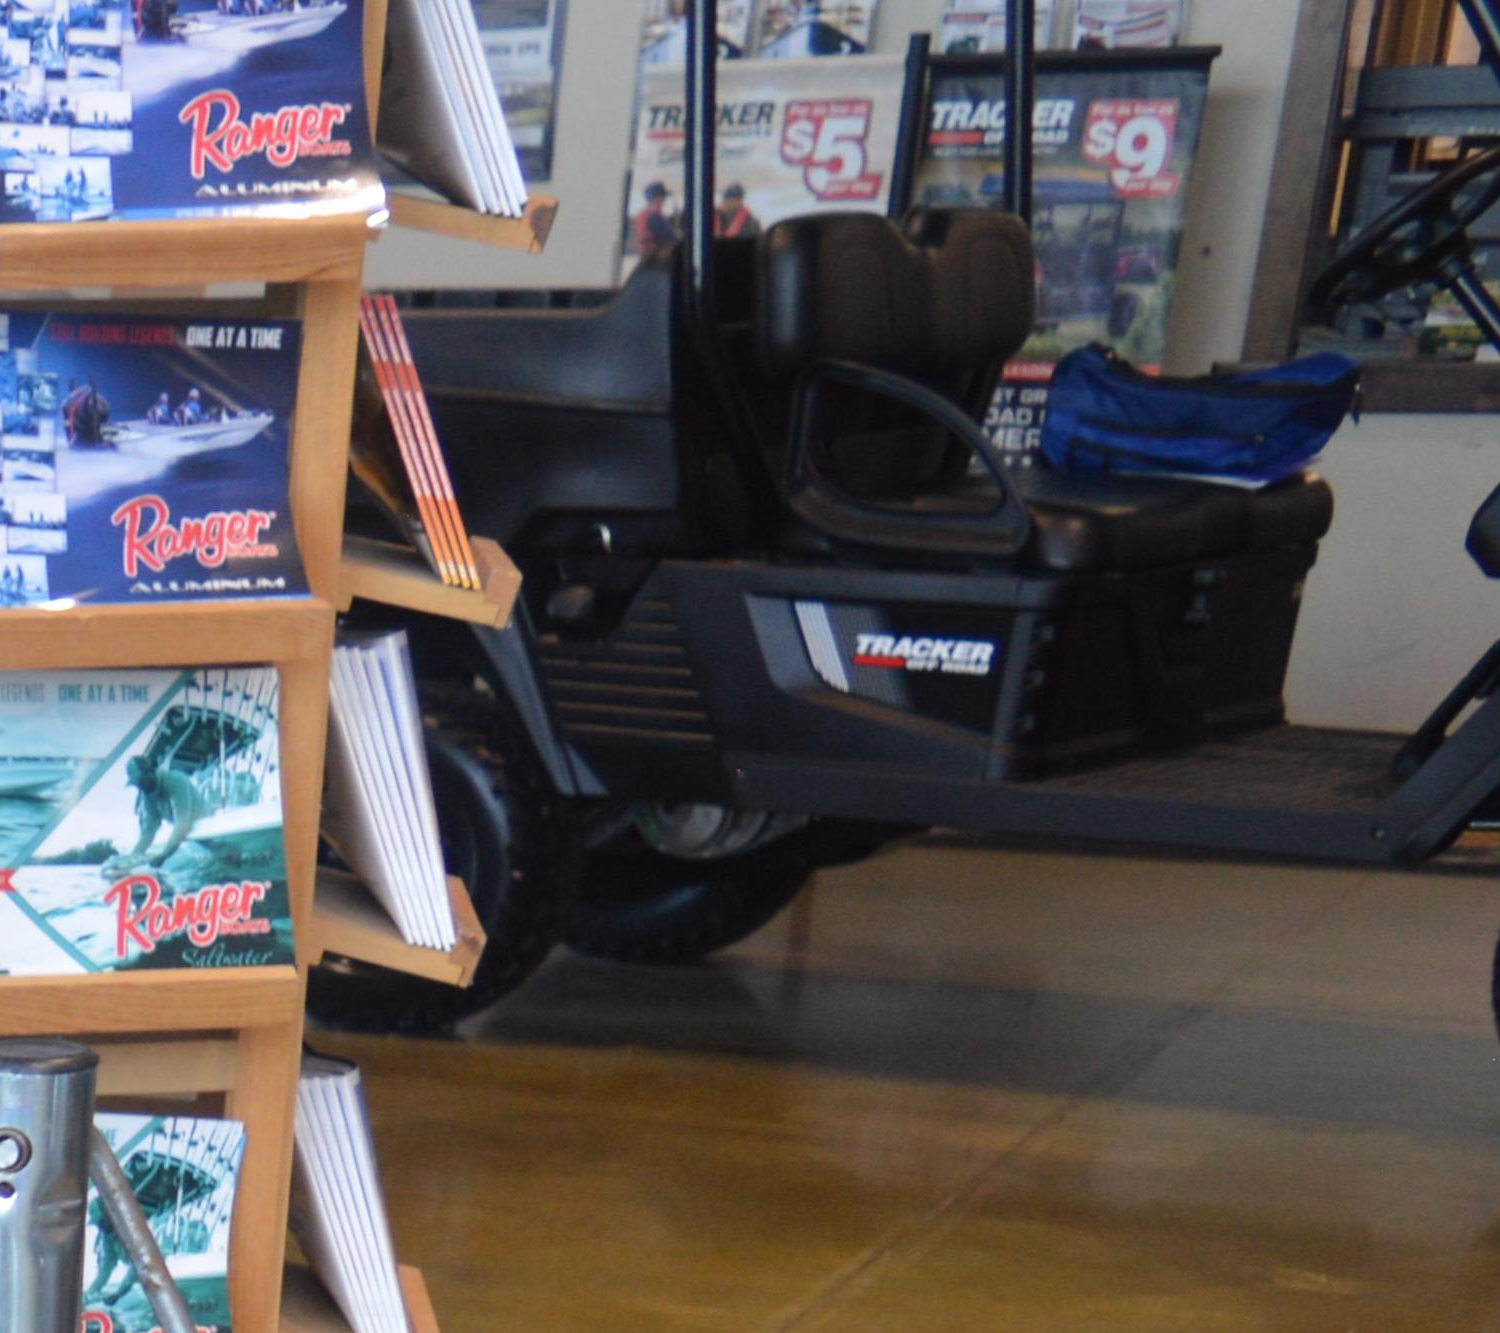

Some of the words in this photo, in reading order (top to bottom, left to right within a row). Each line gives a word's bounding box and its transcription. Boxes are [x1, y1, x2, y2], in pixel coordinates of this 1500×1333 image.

[648, 102, 775, 128] TRKER
[932, 100, 1074, 129] TRACER
[179, 89, 346, 179] Ranger
[783, 115, 865, 195] $5
[1086, 115, 1167, 187] $9
[195, 178, 358, 197] ALUMINUM
[186, 326, 214, 347] ONE
[215, 327, 234, 348] AT
[235, 327, 247, 348] A
[251, 328, 283, 349] TIME
[111, 494, 270, 578] Ranger
[130, 577, 286, 593] ALUMINUM
[856, 633, 994, 662] TRACKER
[58, 684, 82, 702] ONE
[88, 684, 101, 702] AT
[107, 684, 117, 702] A
[121, 684, 150, 702] TIME
[104, 874, 265, 959] Ranger
